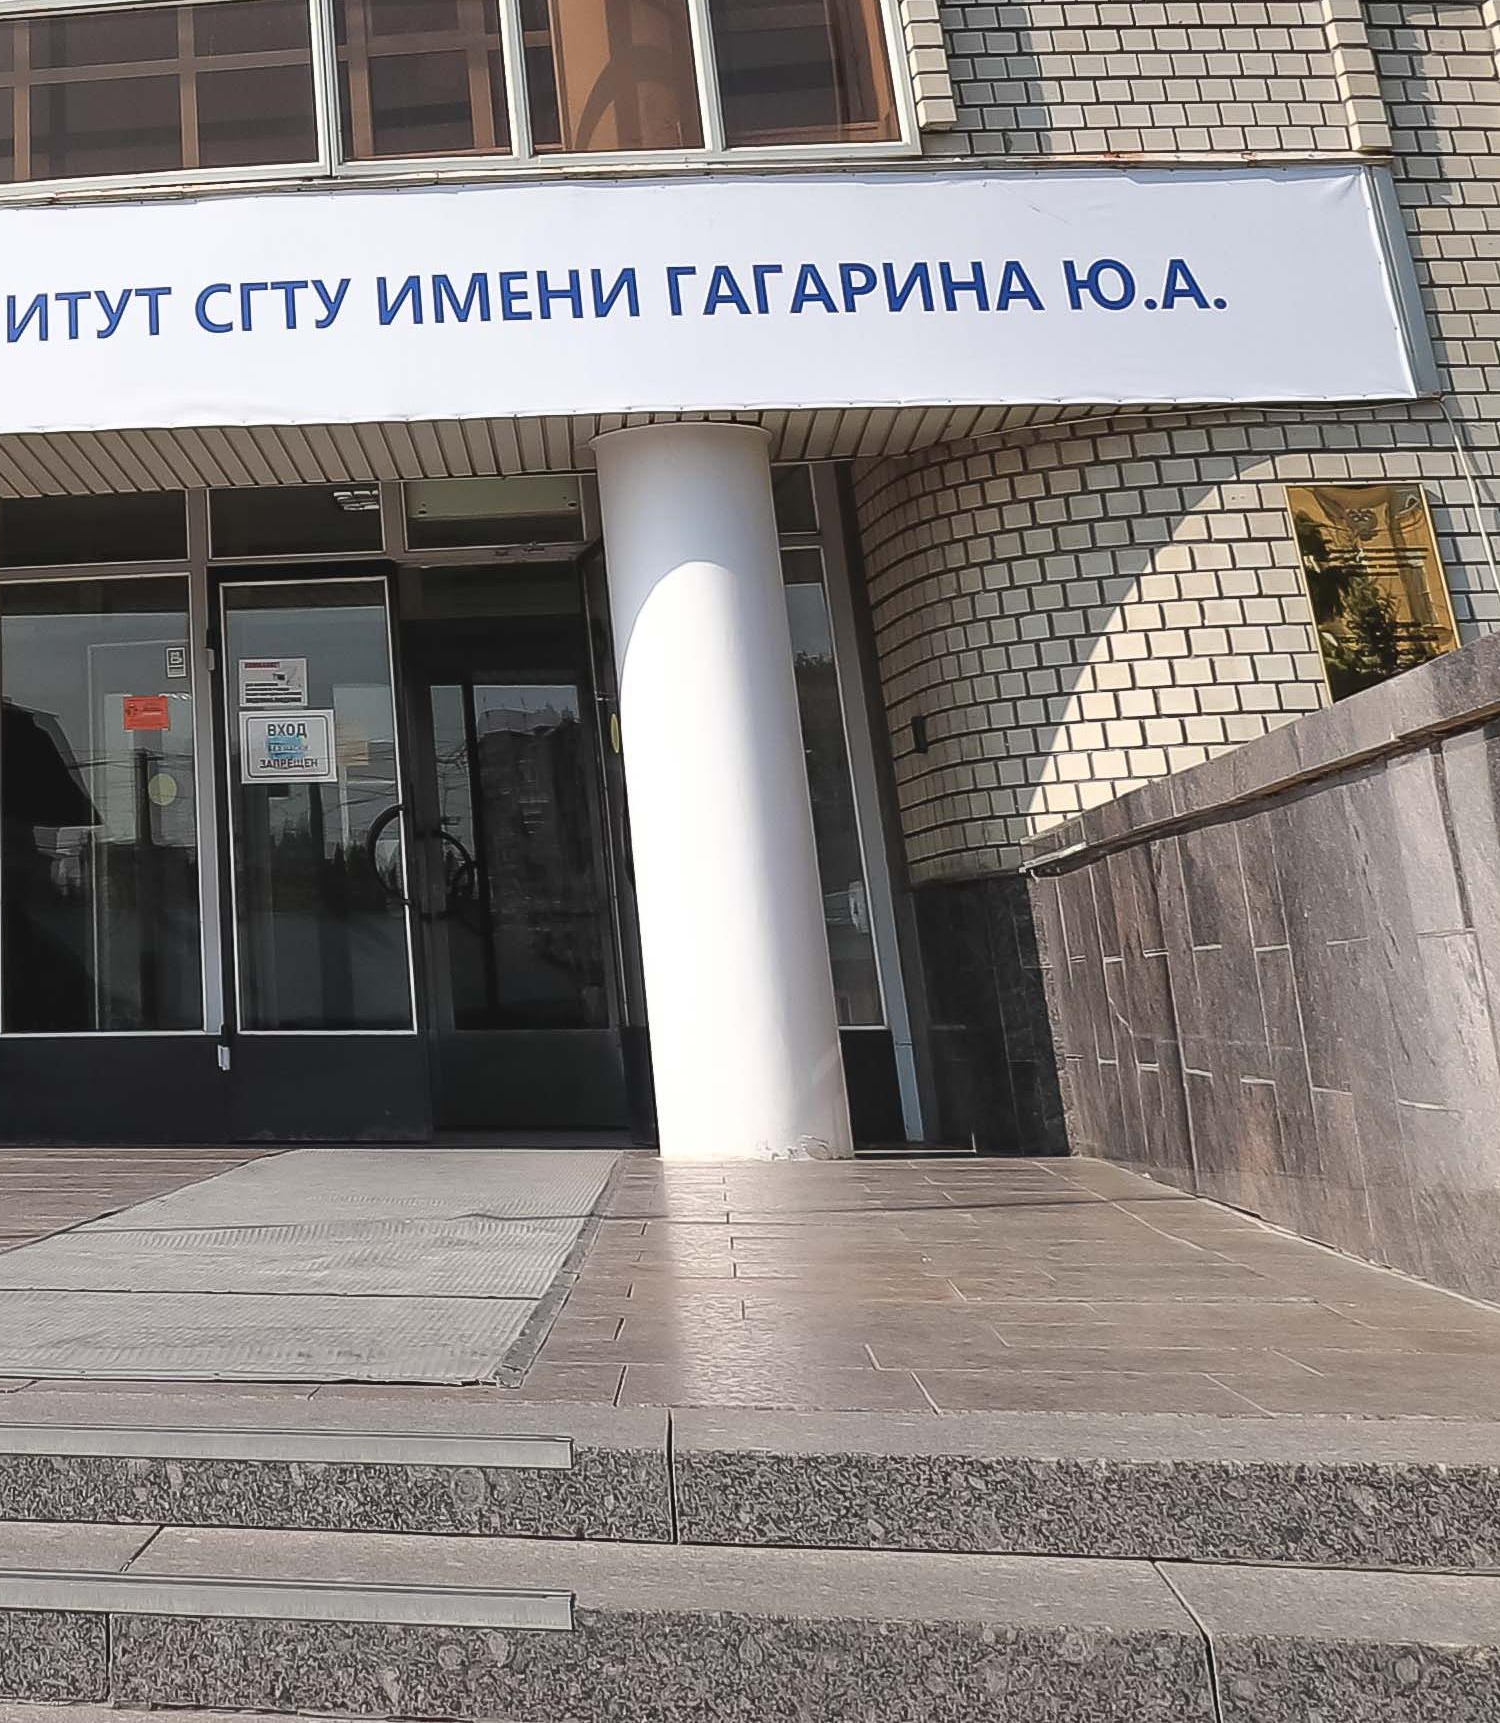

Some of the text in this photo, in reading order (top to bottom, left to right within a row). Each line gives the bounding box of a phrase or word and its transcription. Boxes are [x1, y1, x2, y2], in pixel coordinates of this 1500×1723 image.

[194, 278, 350, 334] СГТУ
[376, 267, 640, 326] ИМЕНИ
[665, 258, 1044, 317] ГАГАРИНА
[1066, 257, 1228, 311] Ю.А.
[267, 723, 307, 738] ВХОД
[259, 758, 318, 769] ЗАПРЕЩЕН
